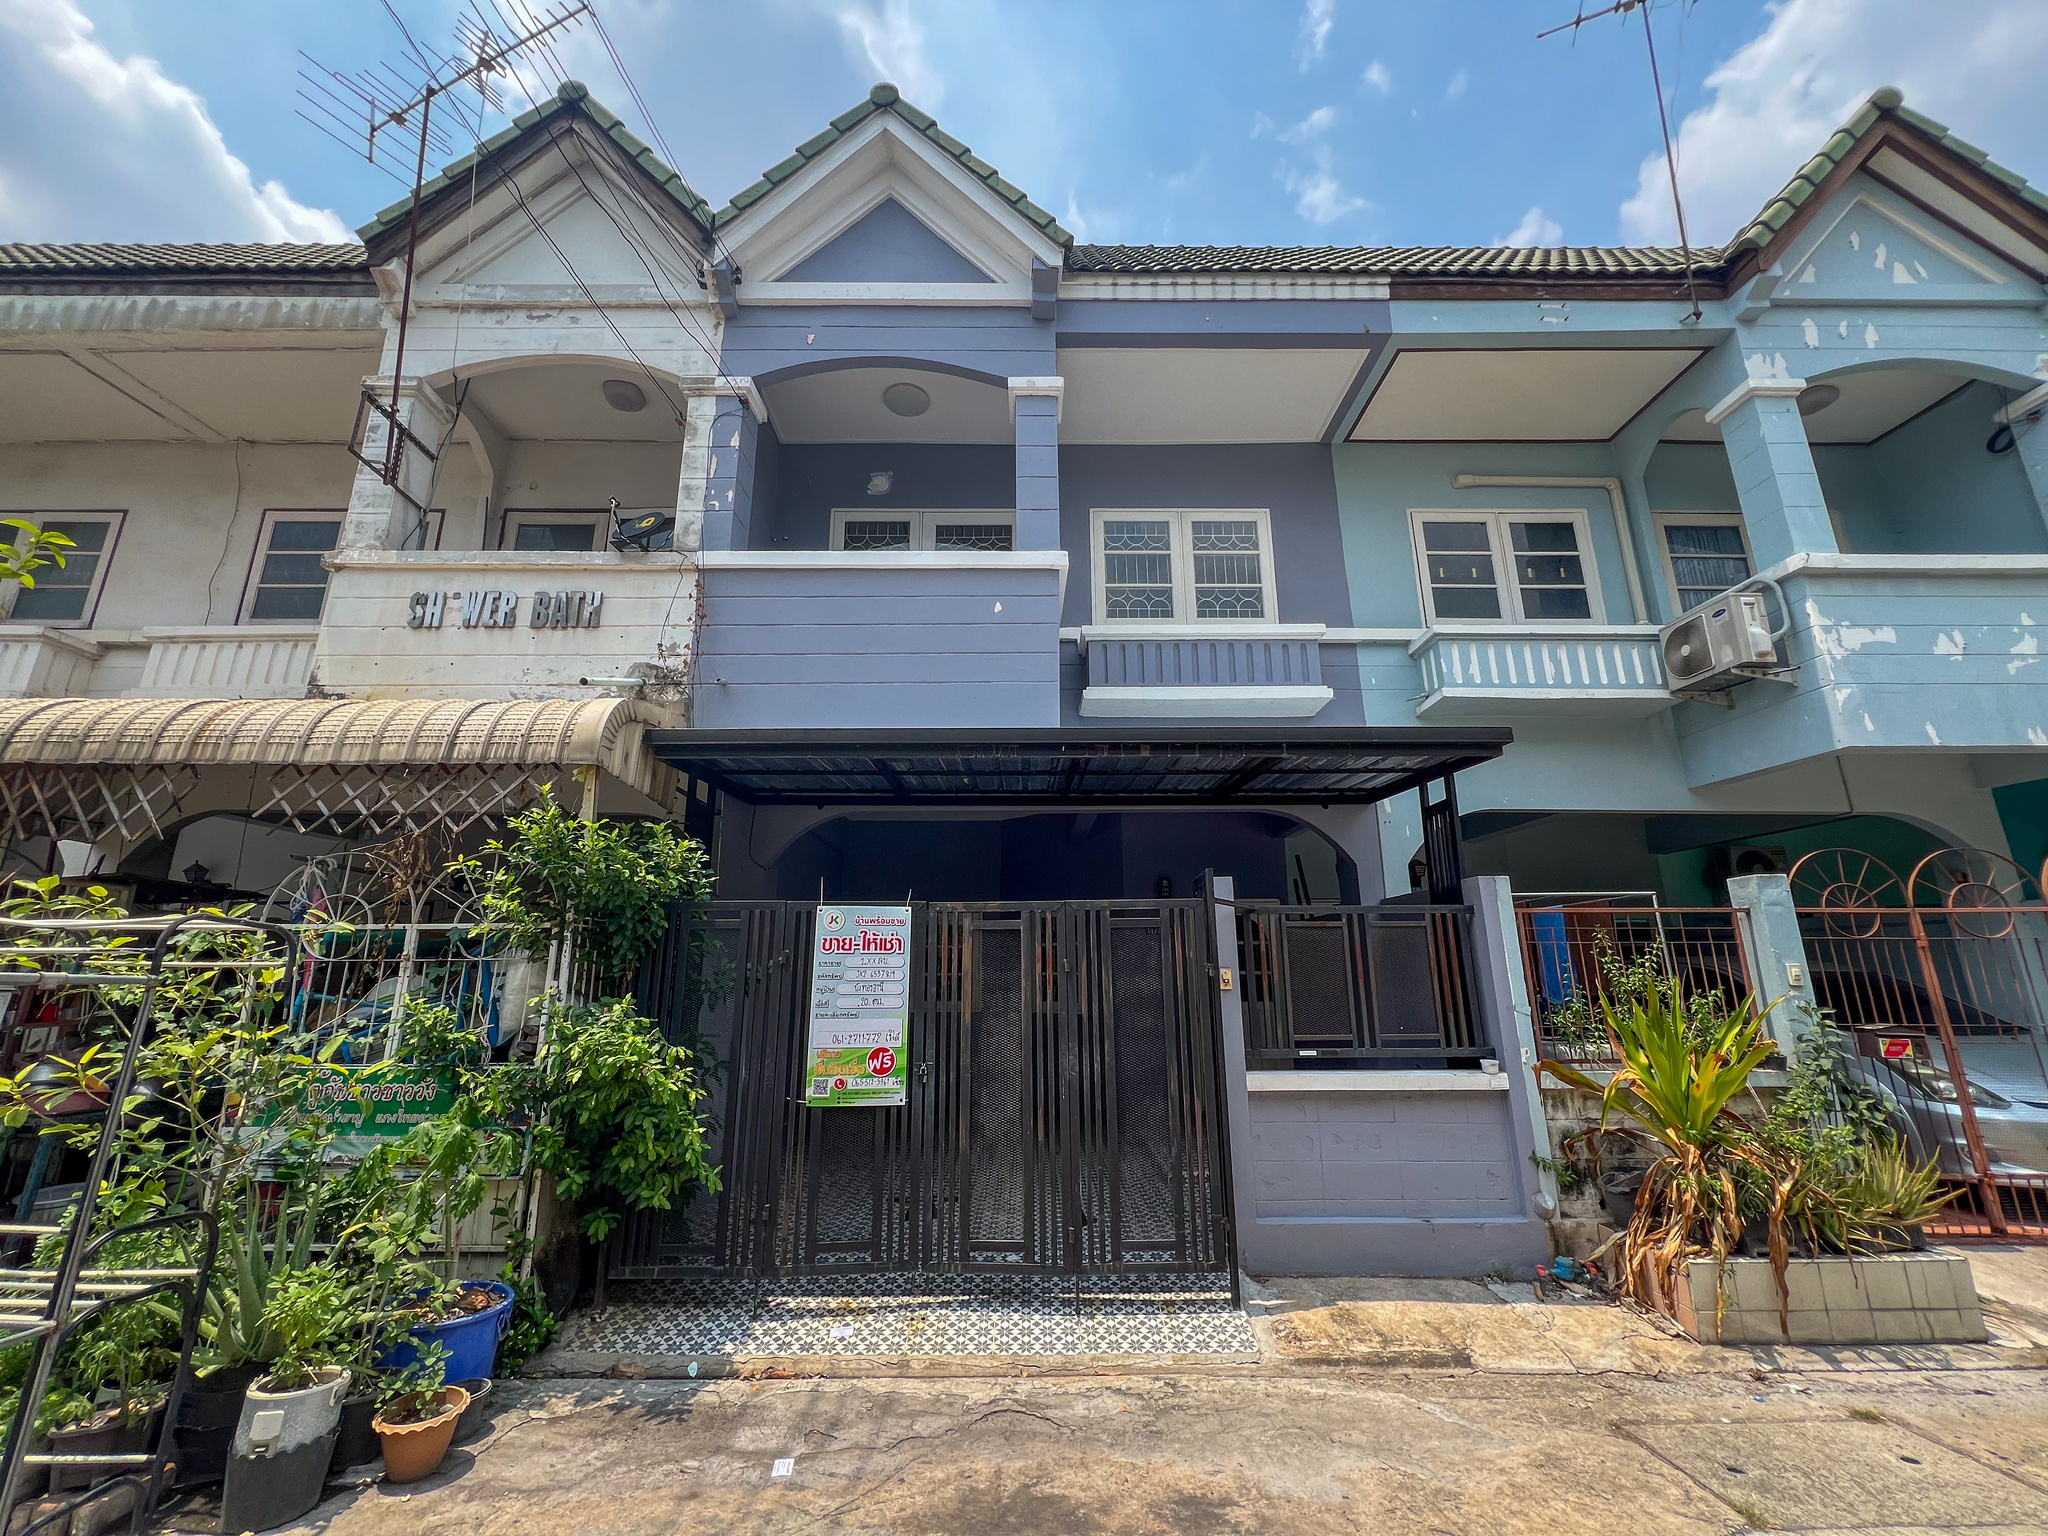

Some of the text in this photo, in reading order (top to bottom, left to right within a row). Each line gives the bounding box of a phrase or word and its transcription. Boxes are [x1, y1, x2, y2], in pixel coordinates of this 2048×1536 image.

[406, 591, 603, 629] SHWER BATH
[854, 915, 906, 926] บ้านพร้อมขาย
[821, 930, 904, 953] ขาย-ให้เช่า
[868, 1050, 893, 1071] ฟรี
